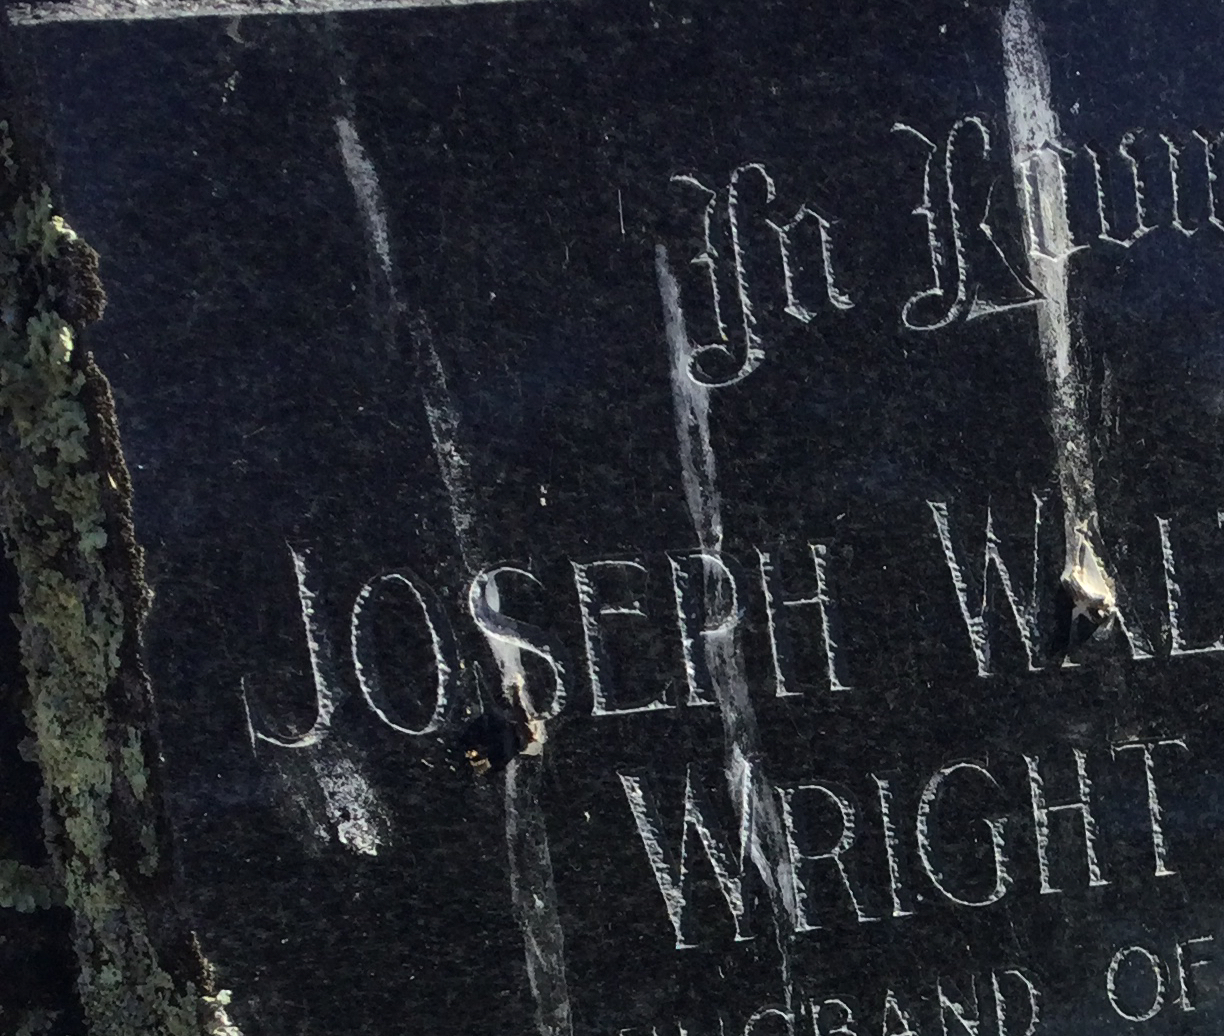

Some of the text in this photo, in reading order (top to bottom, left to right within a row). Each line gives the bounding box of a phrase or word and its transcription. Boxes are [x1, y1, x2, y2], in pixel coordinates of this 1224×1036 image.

[670, 162, 856, 389] In
[240, 538, 852, 750] JOSEPH
[616, 738, 1190, 951] WRIGHT
[1106, 935, 1214, 1023] OF
